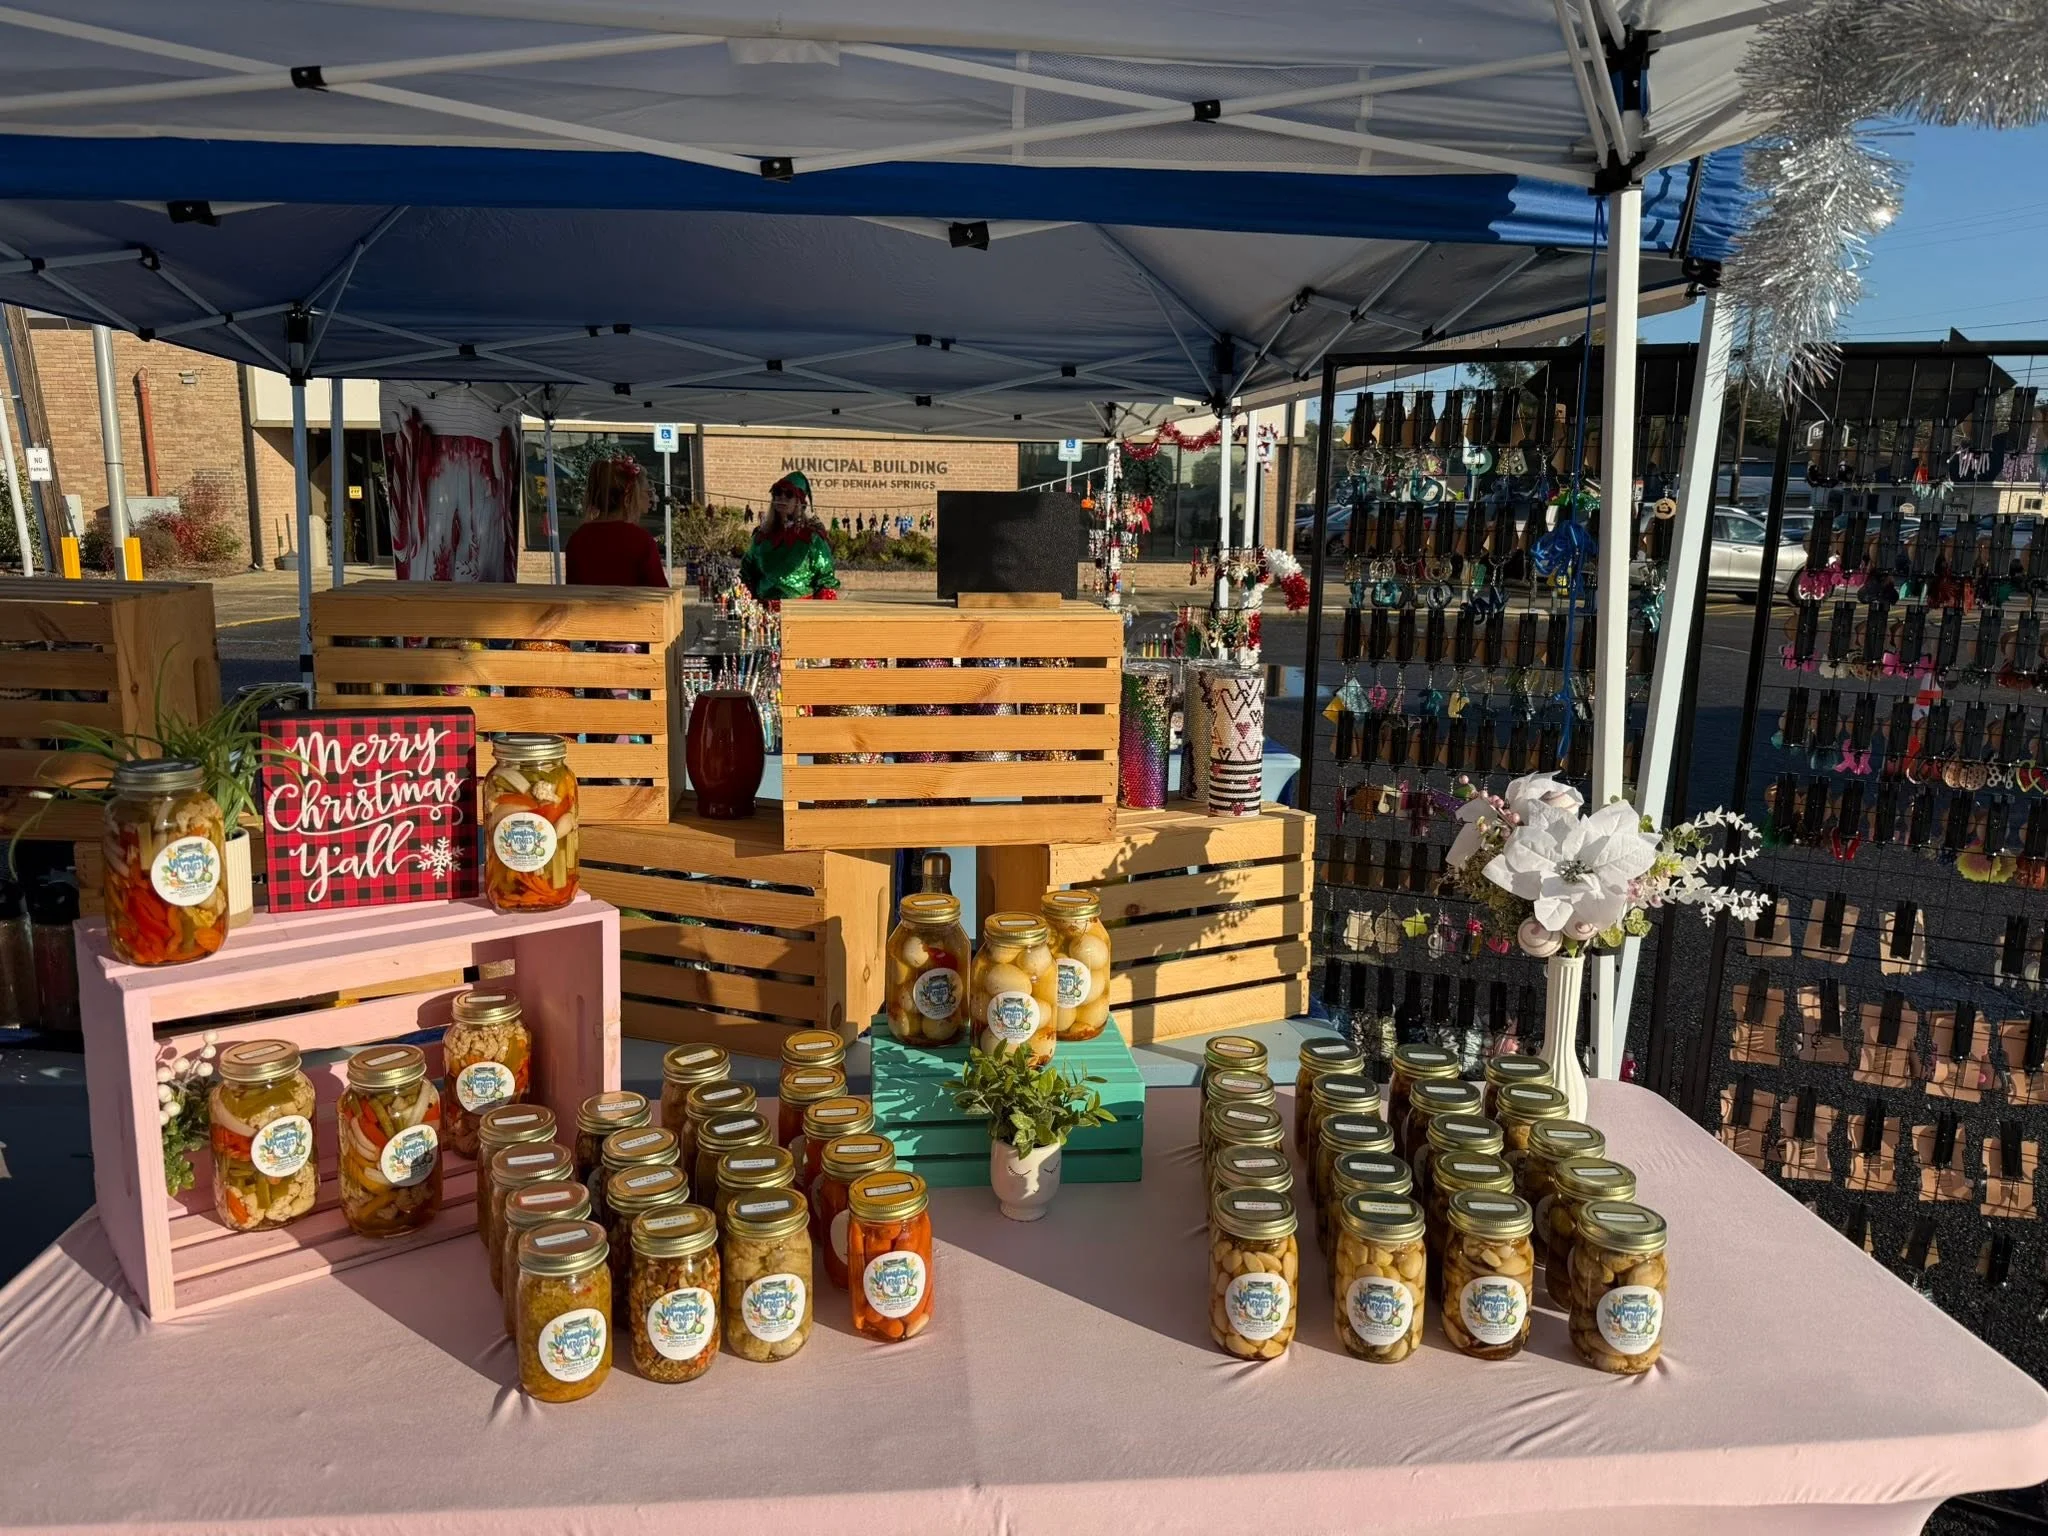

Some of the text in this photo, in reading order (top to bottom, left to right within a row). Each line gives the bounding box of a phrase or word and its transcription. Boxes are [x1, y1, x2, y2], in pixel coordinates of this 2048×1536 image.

[781, 457, 948, 475] MUNICIPAL BUILDING
[824, 479, 840, 488] OF
[842, 479, 887, 489] DENHAM
[890, 480, 936, 490] SPRINGS
[288, 727, 451, 776] Merry
[267, 769, 466, 832] Christmas
